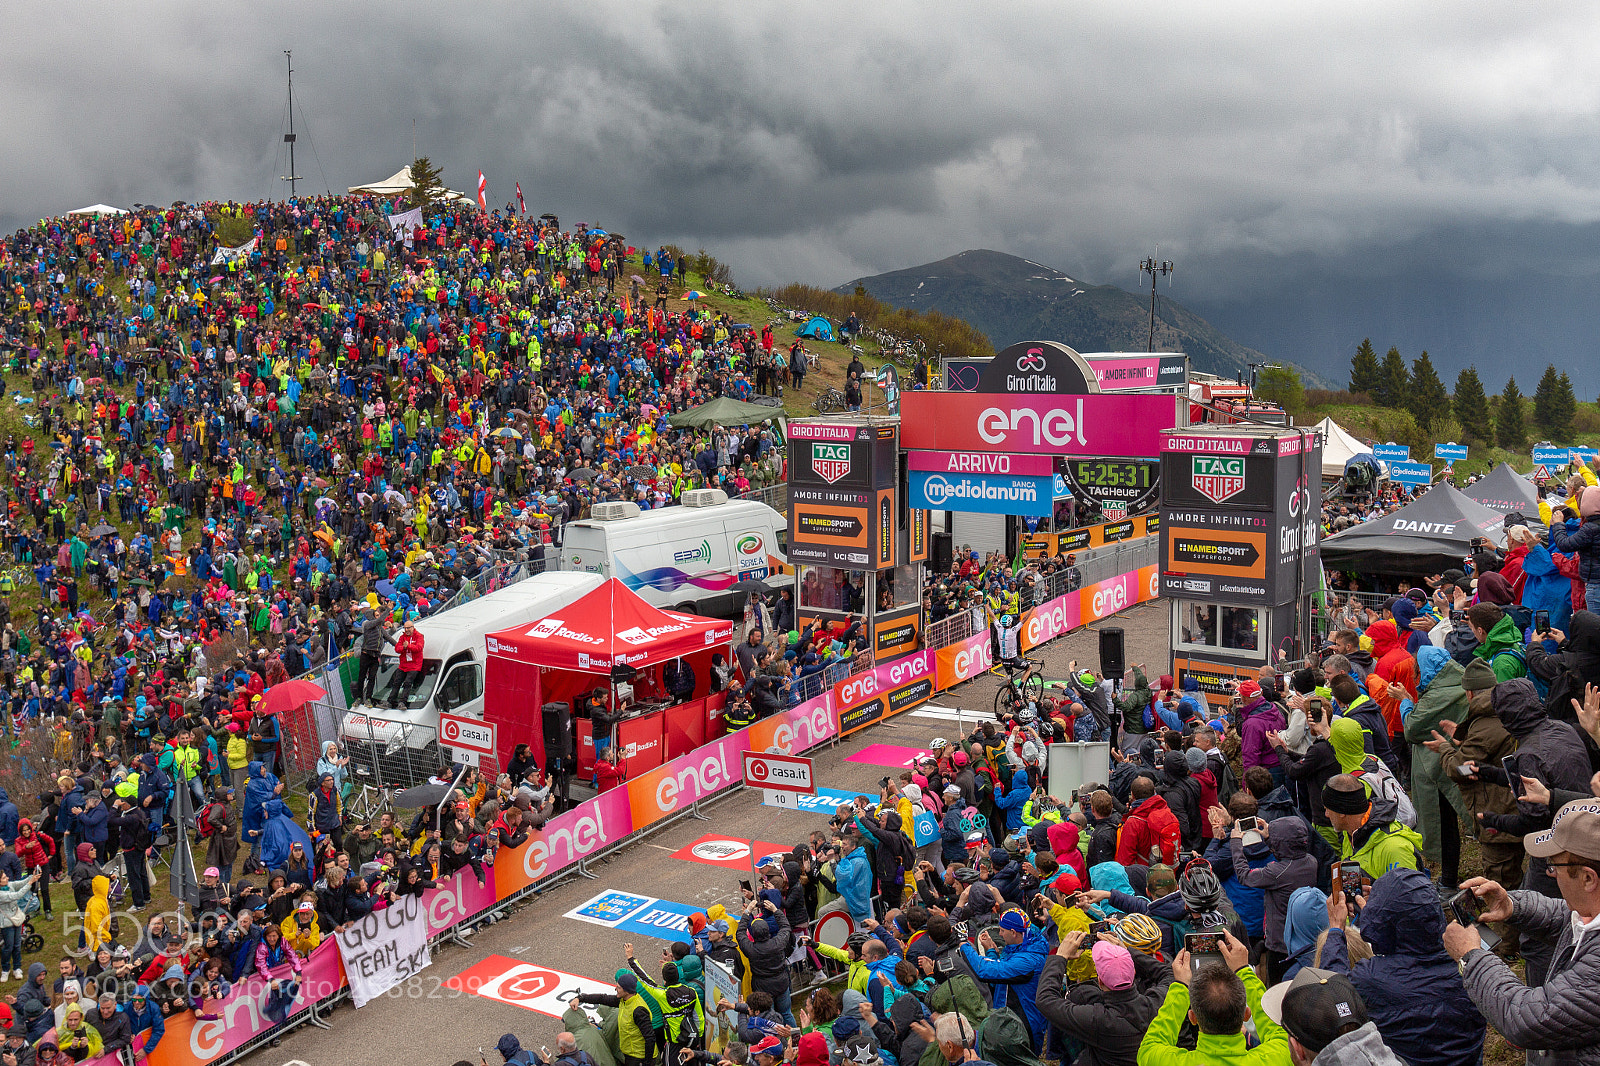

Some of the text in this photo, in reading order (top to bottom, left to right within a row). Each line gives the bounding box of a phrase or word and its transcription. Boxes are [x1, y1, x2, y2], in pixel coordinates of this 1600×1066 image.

[1105, 368, 1126, 380] AMORE
[1007, 375, 1057, 392] Giro d'Italia
[977, 398, 1087, 447] enel
[792, 426, 813, 437] GIRO
[814, 427, 850, 439] D'ITALIA
[815, 445, 847, 459] TAG
[1168, 438, 1194, 450] GIRO
[1197, 439, 1243, 452] D'ITALIA
[815, 461, 850, 481] HEUER
[947, 454, 1010, 473] ARRIVO
[1197, 459, 1240, 474] TAG
[1078, 463, 1150, 488] 5:25:31
[926, 478, 1037, 503] mediolanum
[1012, 480, 1036, 488] BANCA
[1195, 476, 1242, 501] HEUER
[794, 491, 868, 503] AMORE INFINIT01
[1104, 501, 1125, 509] TAG
[808, 518, 853, 528] NAMEDSPORT
[1103, 509, 1127, 521] HEUER
[1168, 513, 1267, 527] AMORE INFINIT01
[1392, 519, 1456, 535] DANTE
[1281, 525, 1294, 554] Giro
[834, 552, 847, 560] UCI
[1186, 544, 1246, 556] NAMEDSPORT
[740, 557, 764, 568] SERIE A
[750, 570, 764, 579] TIM
[1166, 580, 1182, 588] UCI
[1092, 575, 1128, 617] enel
[1028, 597, 1068, 644] enel
[534, 625, 557, 634] Rai
[555, 627, 594, 643] Radio
[626, 631, 649, 643] Rai
[646, 624, 681, 637] Radio
[580, 657, 589, 665] Rai
[590, 659, 607, 667] Radio
[626, 654, 644, 663] Radio
[890, 650, 929, 684] enel
[842, 669, 879, 704] enel
[1191, 674, 1229, 685] NAMEDSP
[895, 683, 928, 702] NAMEDSPORT
[847, 703, 879, 722] NAMEDSPORT
[773, 694, 835, 754] enel
[462, 728, 489, 743] casa.it
[637, 741, 653, 751] Radio
[461, 753, 470, 762] 10
[655, 742, 731, 812] enel
[772, 766, 807, 780] casa.it
[775, 794, 786, 804] 10
[523, 800, 607, 879] enel
[425, 872, 467, 935] el
[343, 892, 418, 948] GO GO
[635, 908, 691, 933] EUR
[348, 939, 400, 979] TEAM
[395, 944, 427, 981] SKY
[189, 968, 305, 1060] en
